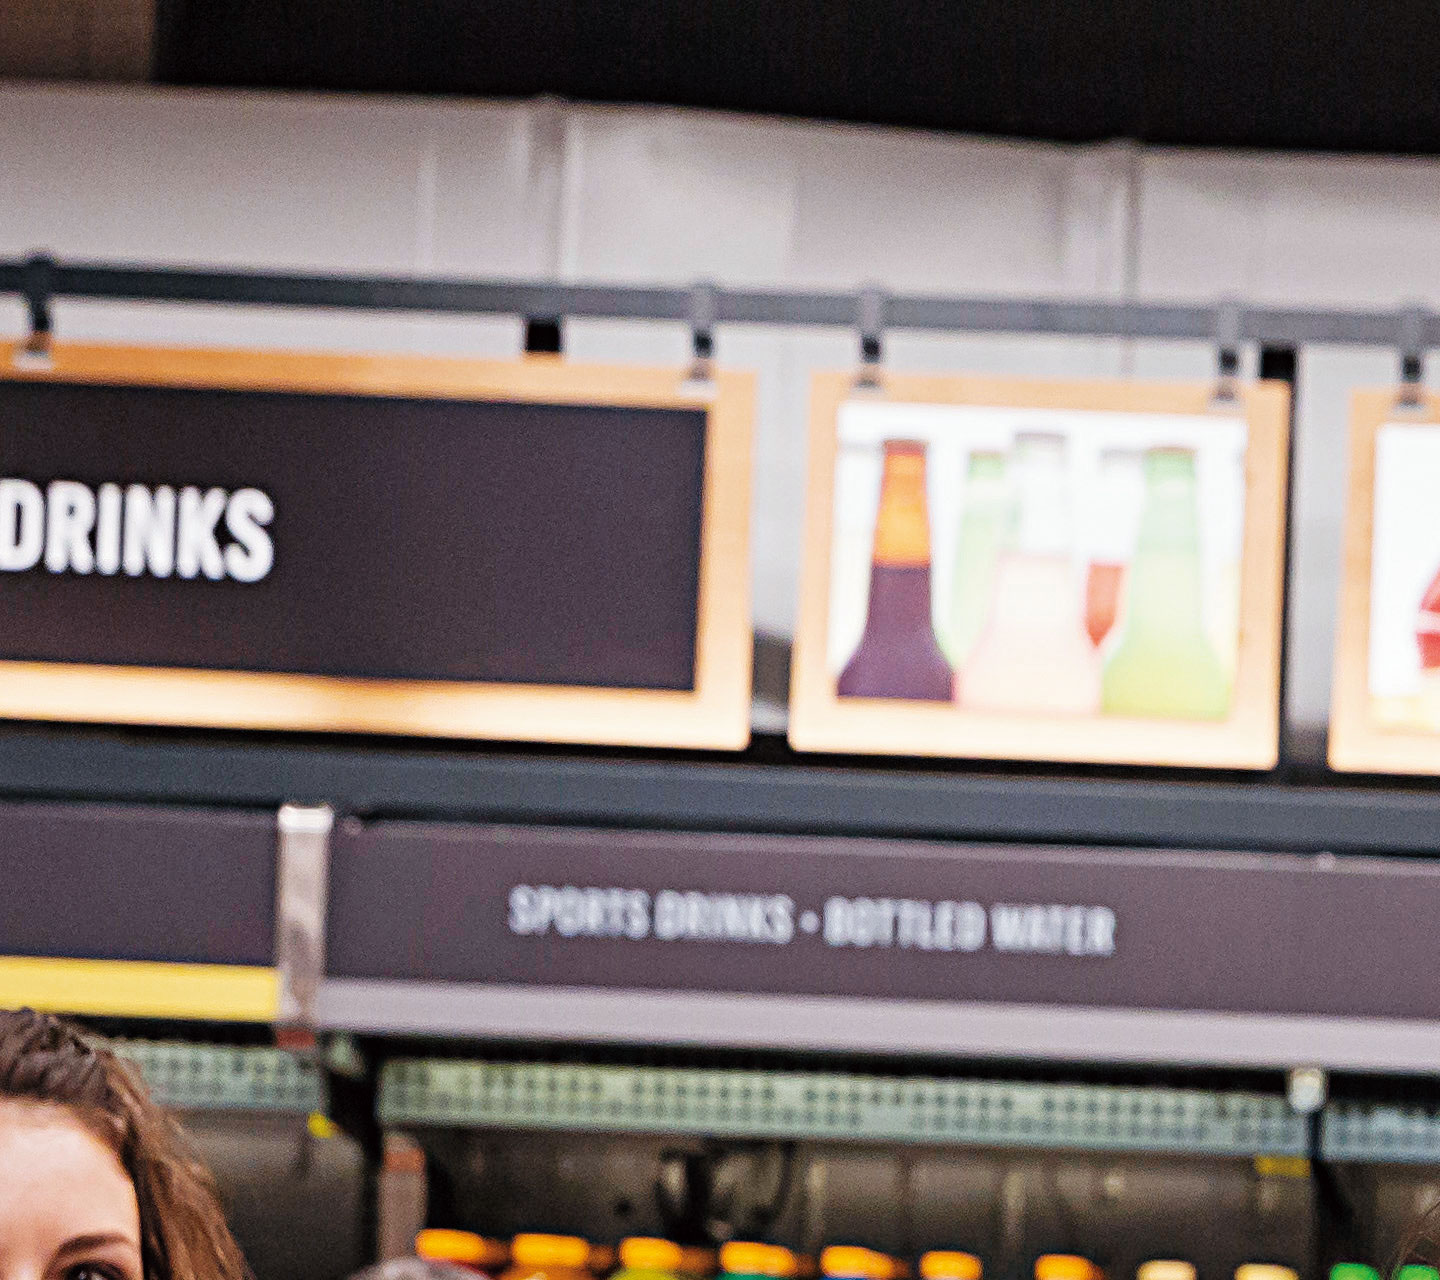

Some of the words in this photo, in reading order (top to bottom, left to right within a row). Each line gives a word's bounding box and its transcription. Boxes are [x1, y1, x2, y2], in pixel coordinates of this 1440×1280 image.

[510, 886, 649, 938] SPORTS
[655, 891, 793, 943] DRINKS
[825, 897, 986, 950] BOTTLED
[992, 905, 1115, 954] WATER
